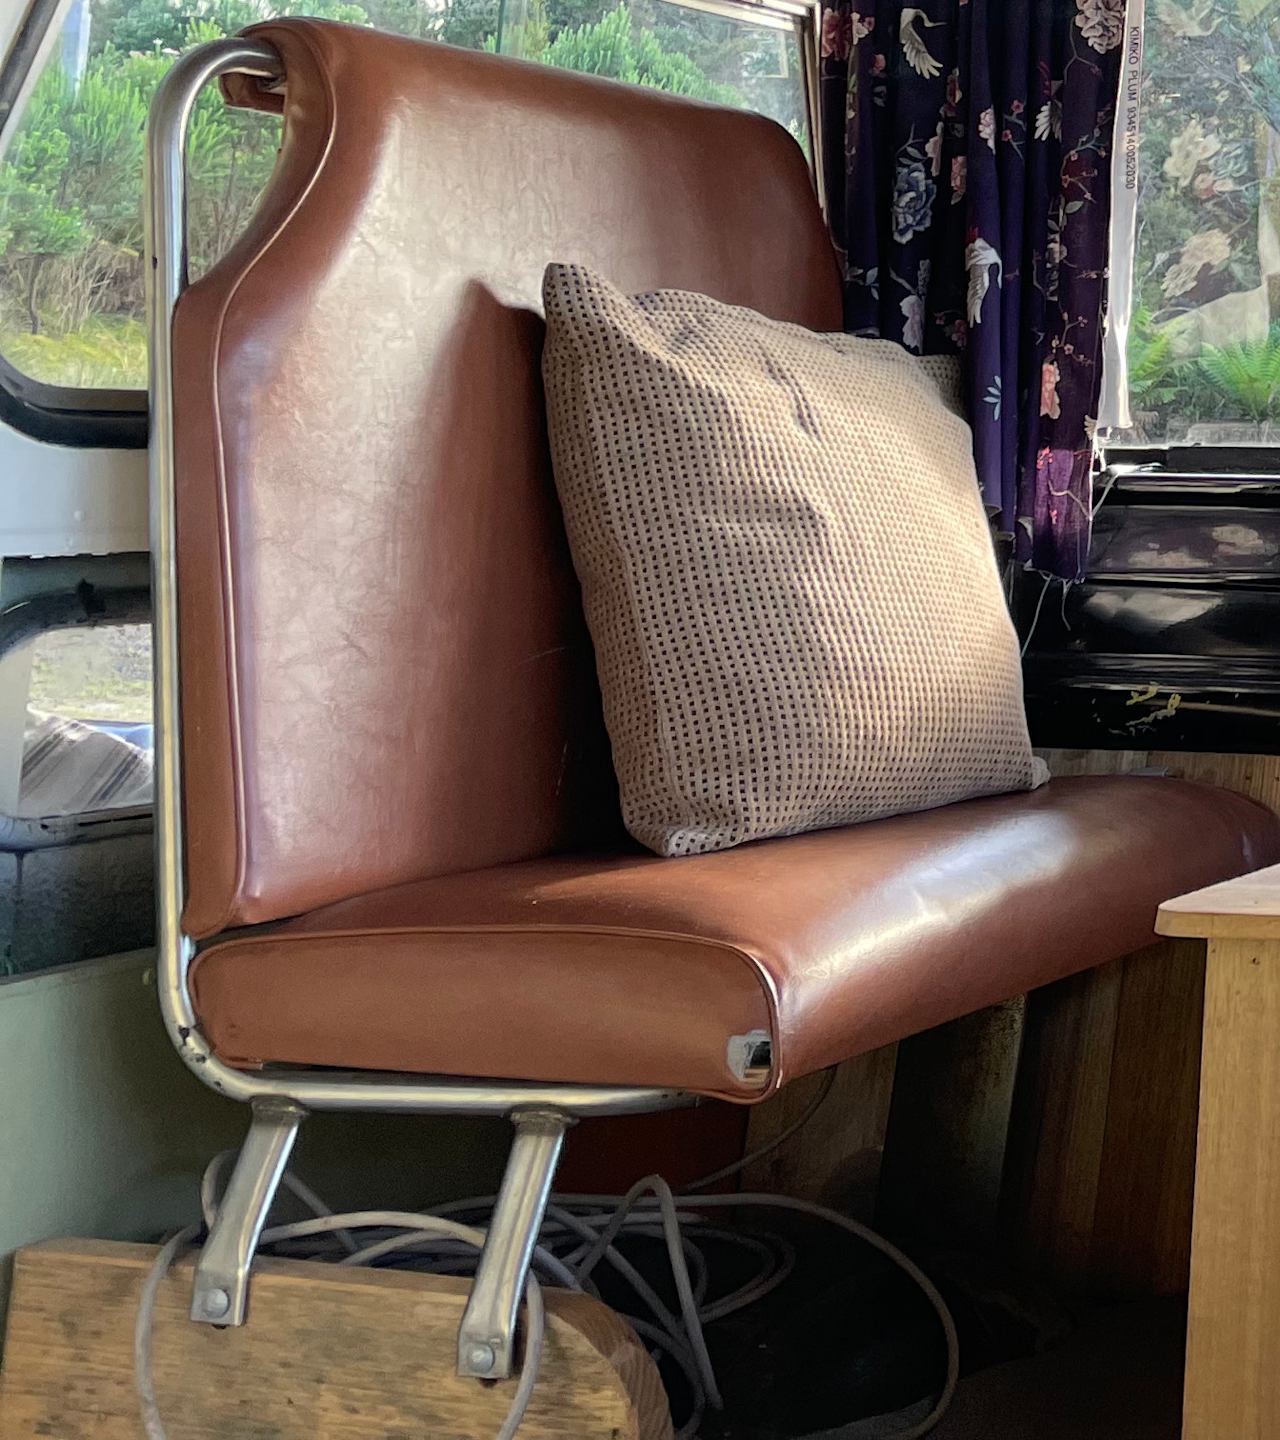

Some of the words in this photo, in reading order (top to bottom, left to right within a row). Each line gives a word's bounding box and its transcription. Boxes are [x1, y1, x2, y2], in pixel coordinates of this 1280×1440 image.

[1128, 26, 1140, 65] KIMIKO
[1127, 70, 1139, 101] PLUM
[1125, 106, 1137, 190] 9345140052030
